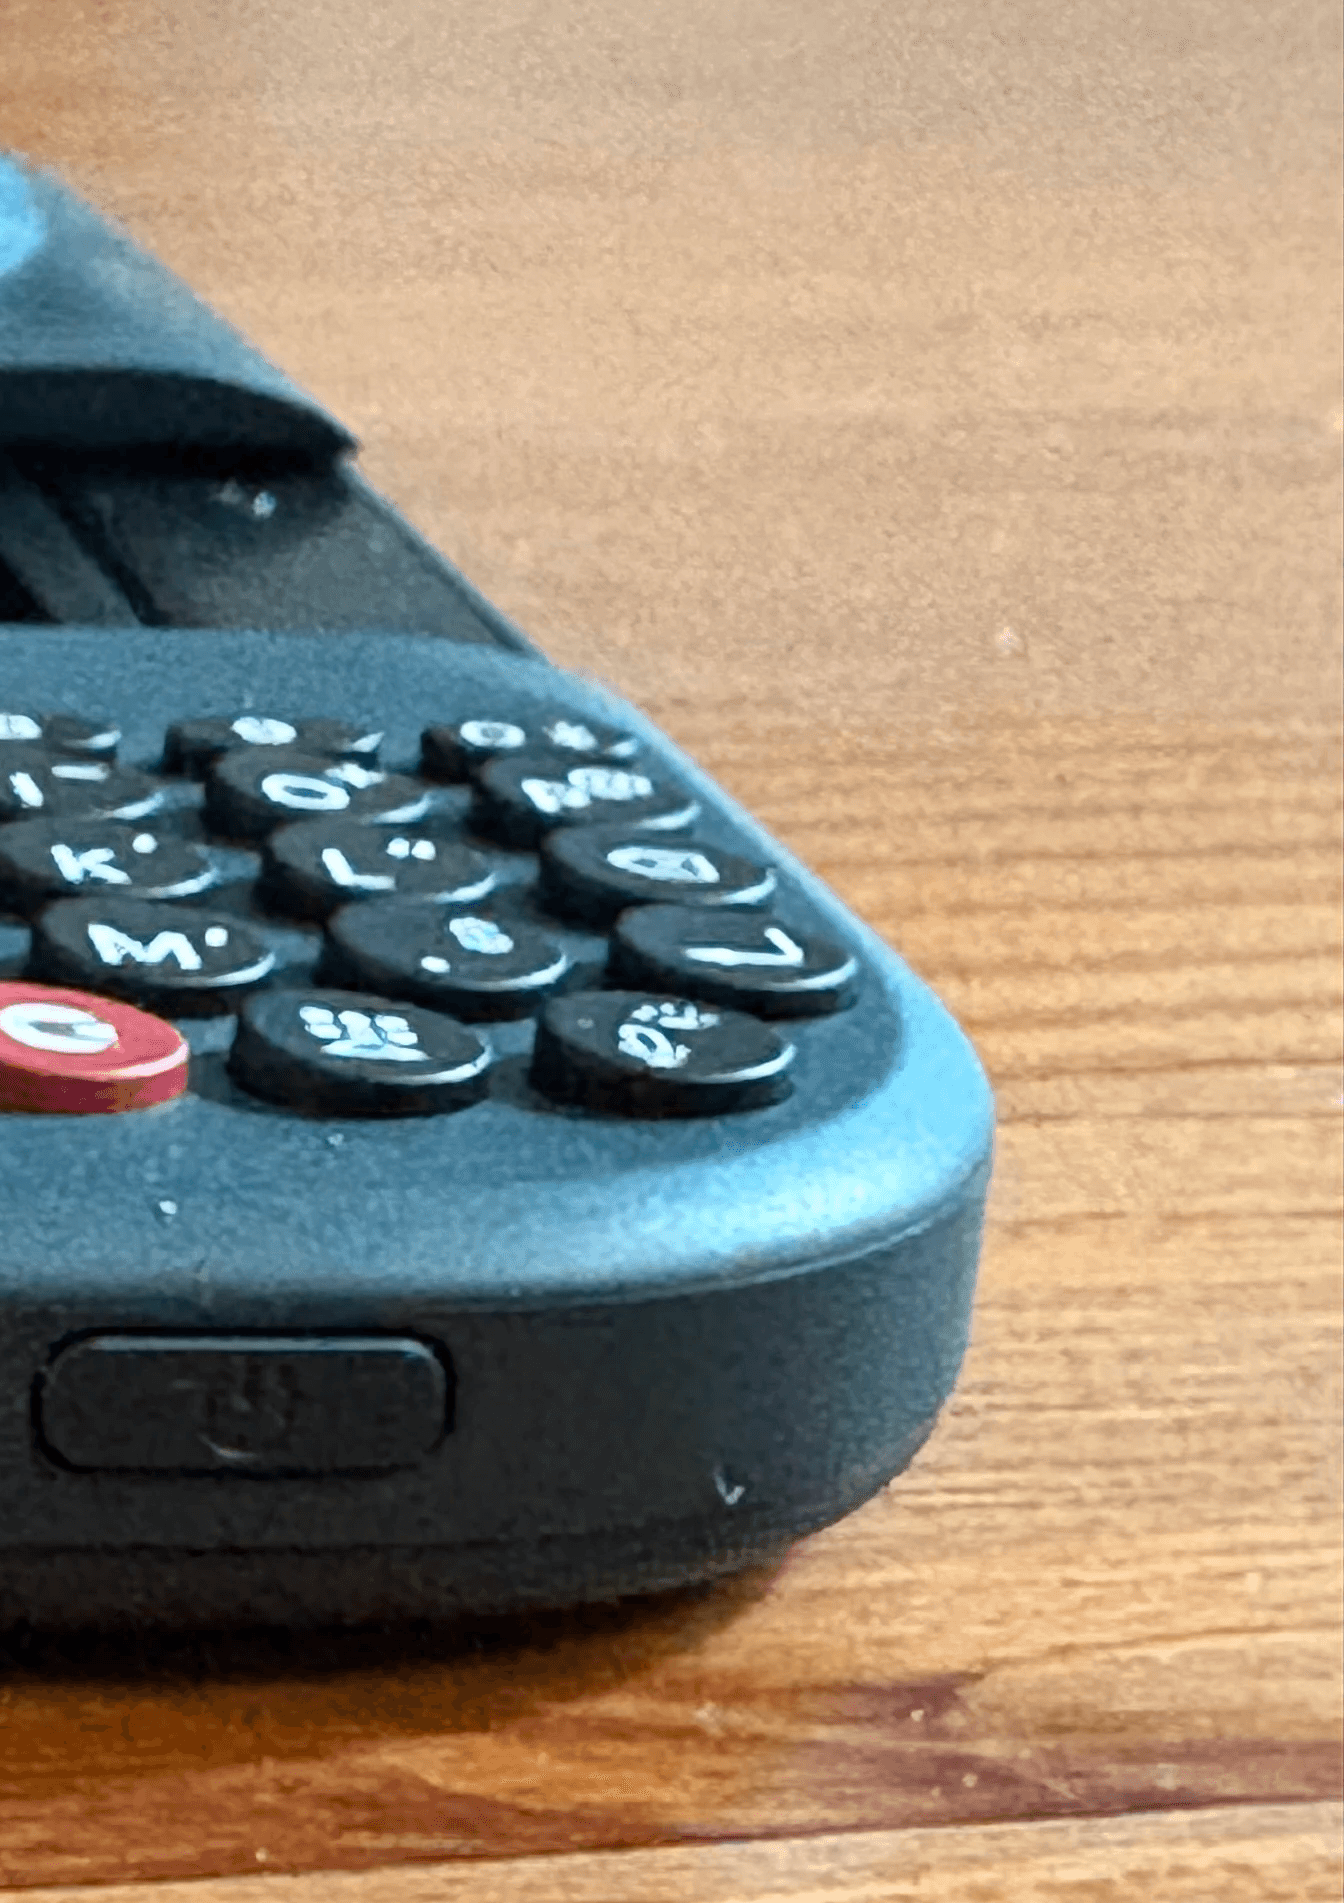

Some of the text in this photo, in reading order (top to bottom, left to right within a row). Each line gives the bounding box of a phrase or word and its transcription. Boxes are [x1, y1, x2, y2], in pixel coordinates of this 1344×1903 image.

[49, 843, 133, 886] K
[320, 846, 397, 891] L
[86, 922, 203, 971] M
